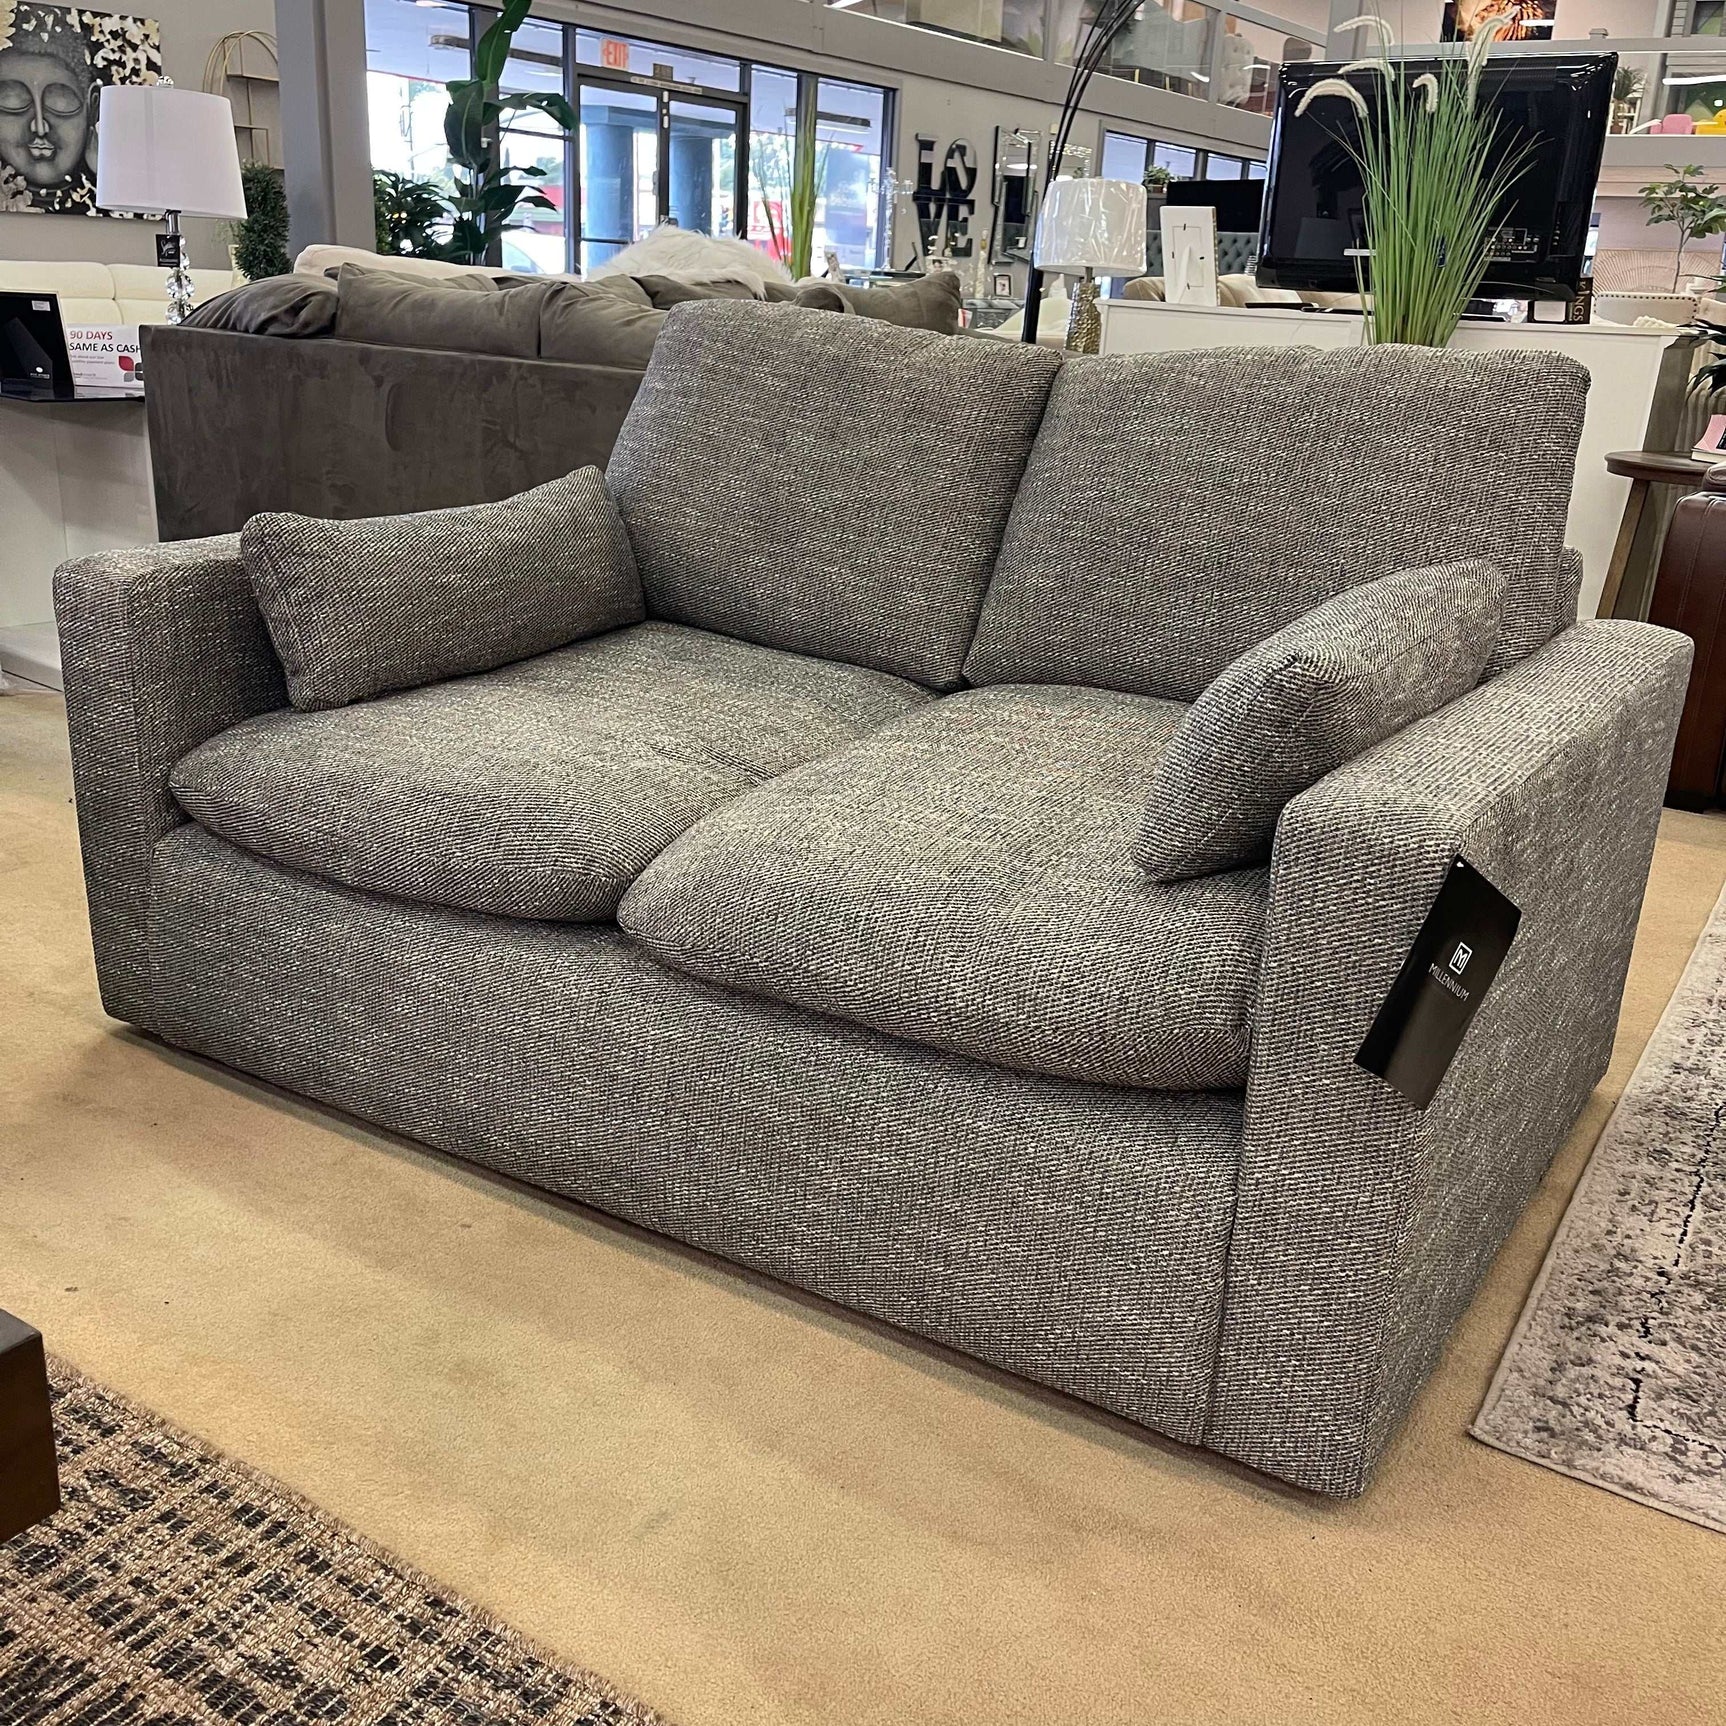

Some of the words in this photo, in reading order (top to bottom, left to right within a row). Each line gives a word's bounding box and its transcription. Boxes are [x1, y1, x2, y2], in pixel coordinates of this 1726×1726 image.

[606, 40, 628, 69] EXIT
[70, 331, 83, 340] 90
[86, 331, 113, 340] DAYS
[69, 342, 98, 352] SAME
[100, 343, 114, 352] AS
[1428, 963, 1470, 1001] MILLENNIUM
